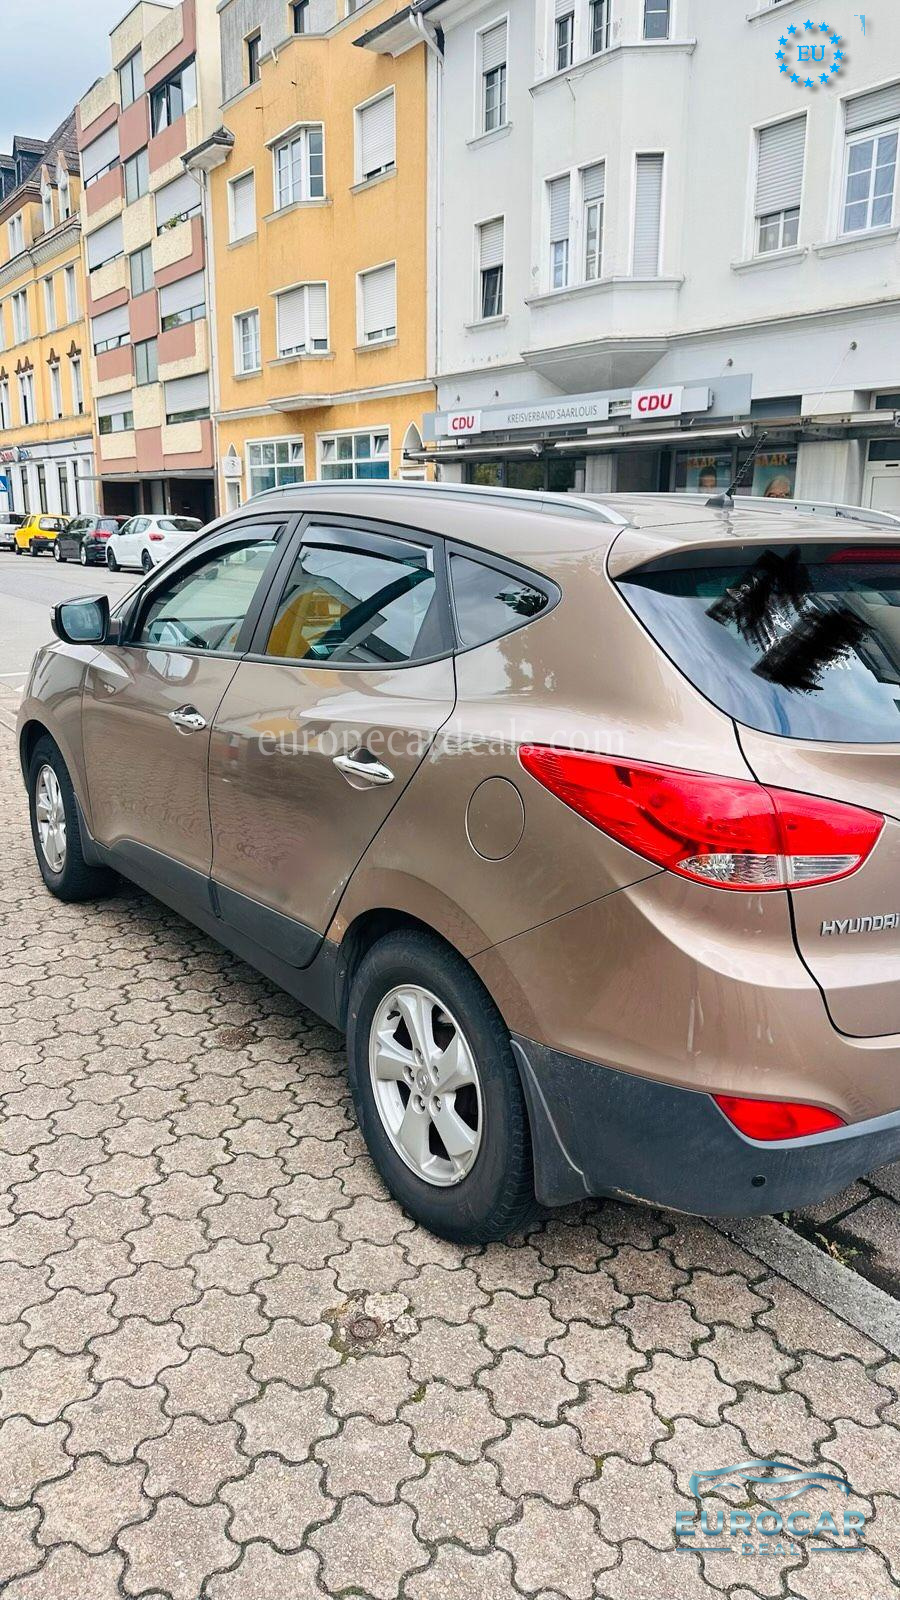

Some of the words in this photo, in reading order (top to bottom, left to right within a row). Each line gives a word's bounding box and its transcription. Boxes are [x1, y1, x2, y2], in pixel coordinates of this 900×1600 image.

[637, 393, 673, 412] CDU
[452, 415, 475, 430] CDU
[507, 410, 556, 424] KREISVERBAND
[557, 405, 598, 420] SAARLOUIS
[820, 913, 900, 936] HYUNDAI
